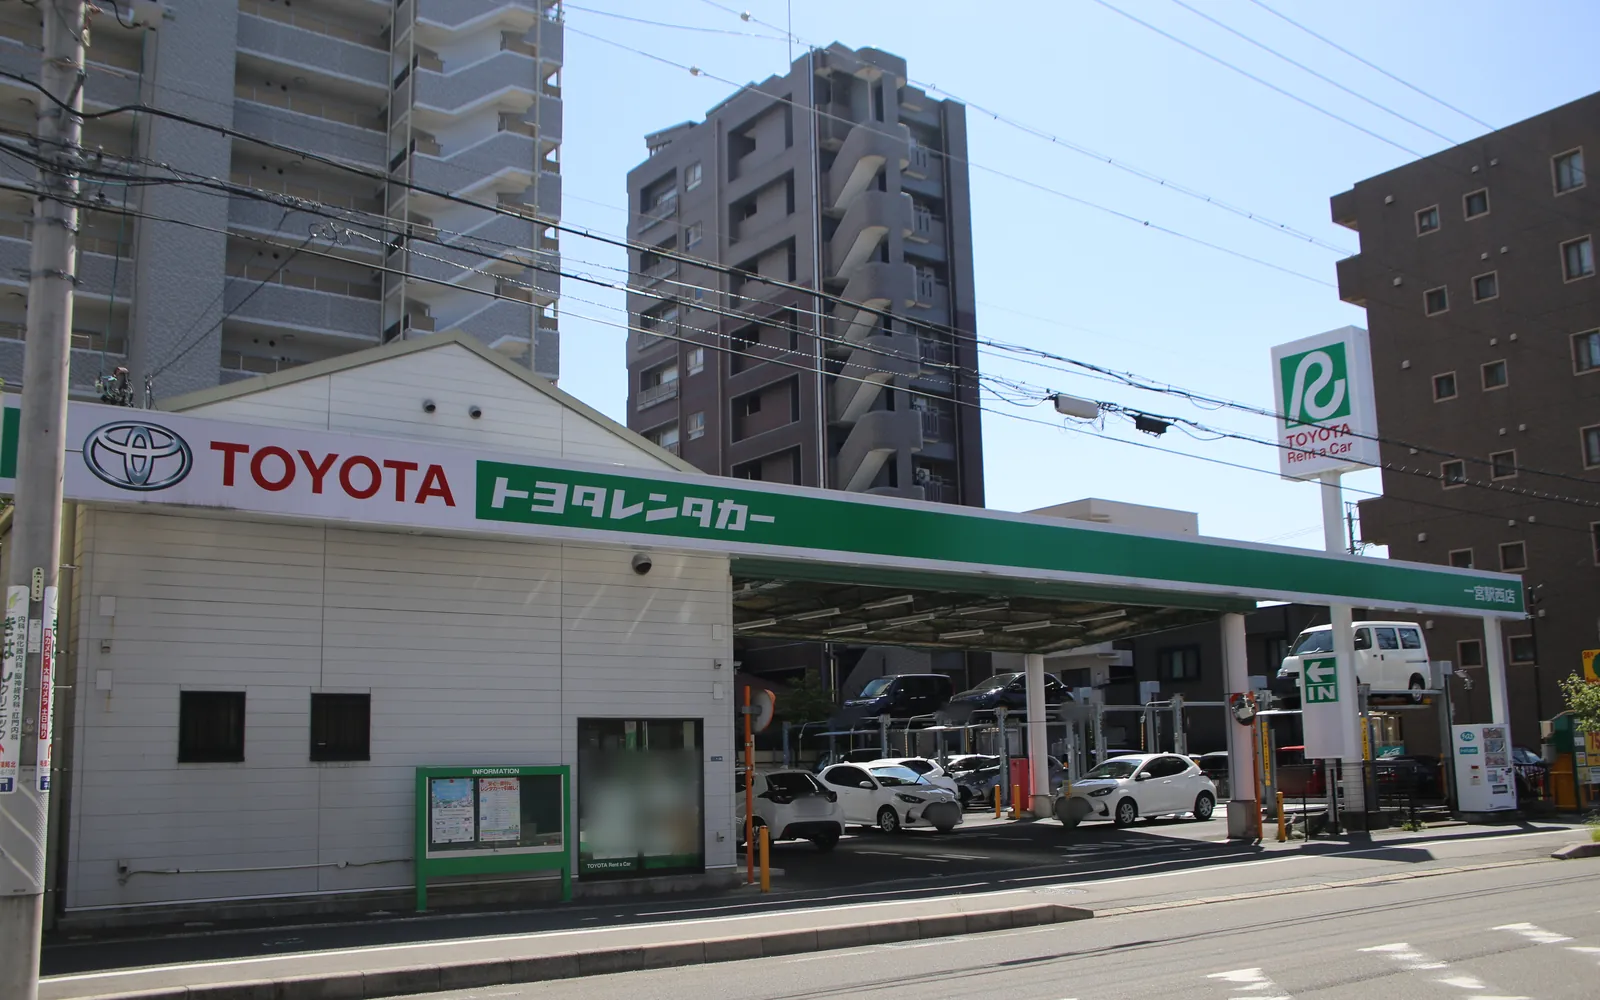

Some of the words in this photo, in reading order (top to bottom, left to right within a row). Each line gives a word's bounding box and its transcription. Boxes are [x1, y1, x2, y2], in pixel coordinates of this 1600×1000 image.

[1286, 423, 1351, 449] TOYOTA
[1287, 448, 1316, 463] Rent
[1319, 448, 1327, 457] a
[1330, 441, 1353, 455] Car
[210, 440, 456, 508] TOYOTA
[491, 476, 776, 532] トヨタレンタカー
[1463, 585, 1516, 604] 一宮駅西店
[1307, 686, 1336, 701] IN
